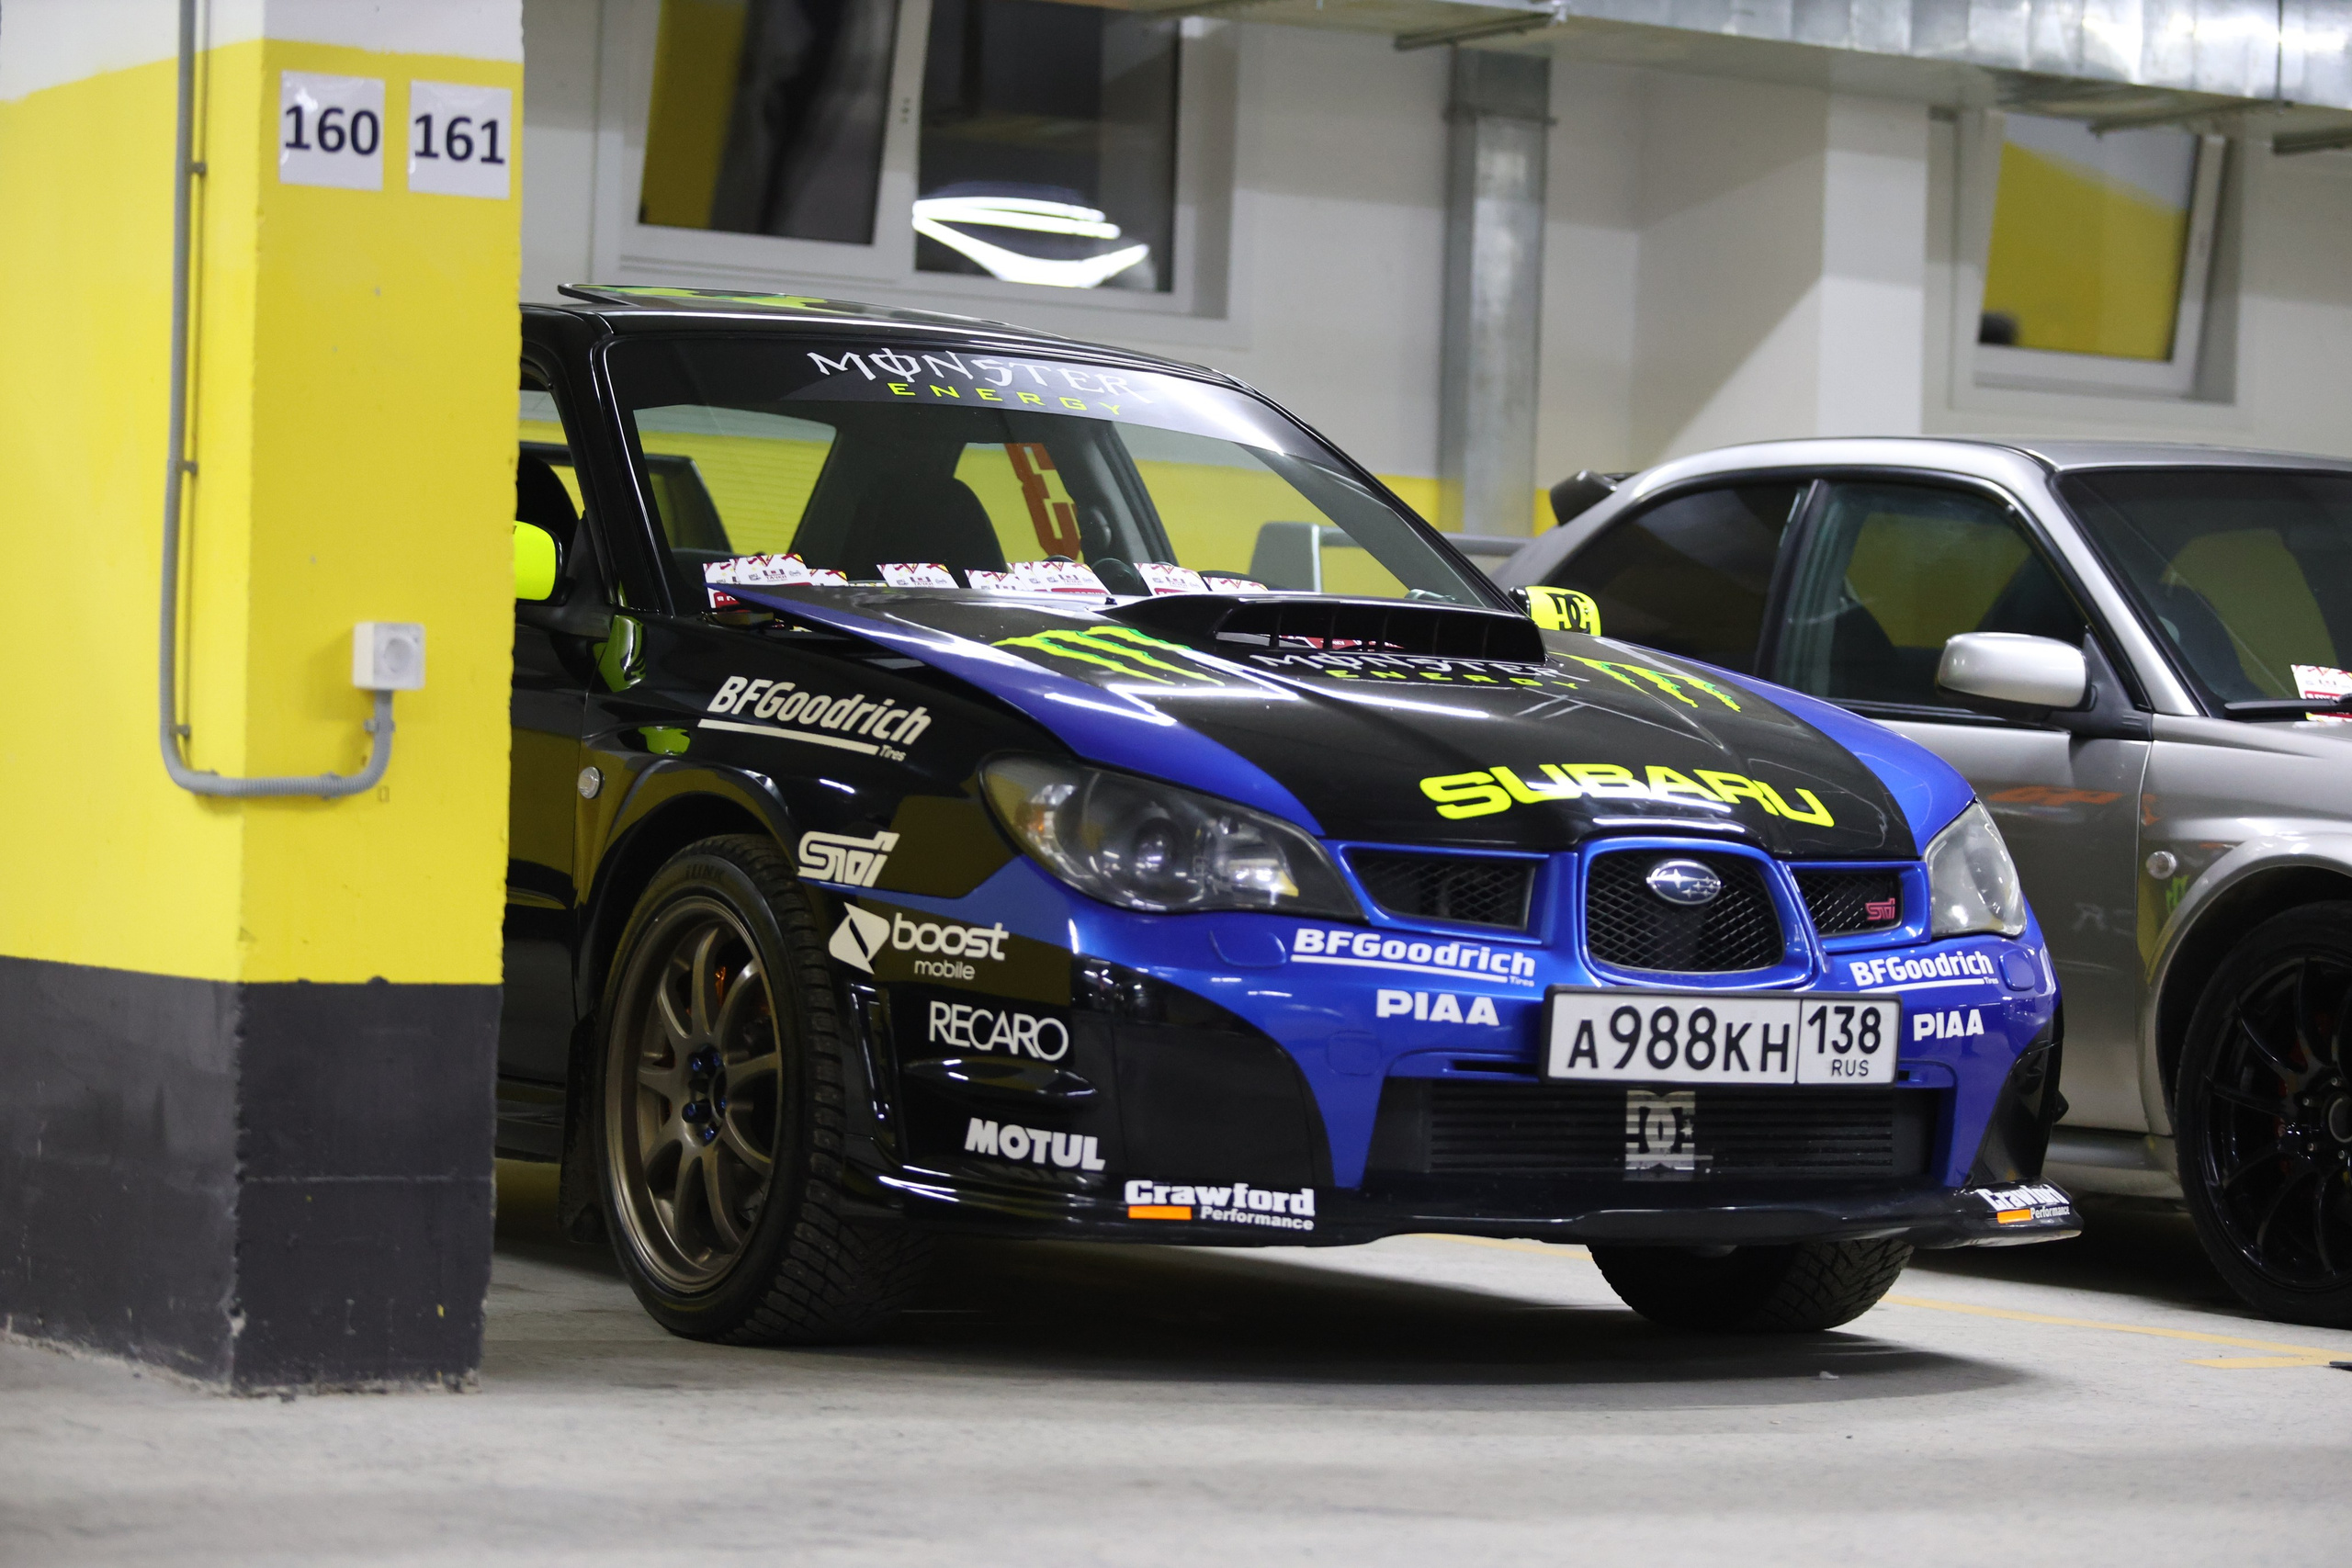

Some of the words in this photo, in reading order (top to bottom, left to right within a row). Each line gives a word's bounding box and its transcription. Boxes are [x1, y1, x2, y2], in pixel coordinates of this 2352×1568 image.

[285, 105, 379, 155] 160
[414, 114, 504, 164] 161
[888, 382, 1120, 415] ENERGY
[1325, 670, 1578, 690] ENERGY
[707, 675, 932, 746] BFGoodrich
[878, 744, 907, 762] Tires
[1419, 763, 1835, 827] SUBARU
[891, 912, 1010, 961] boost
[1293, 928, 1536, 977] BFGoodrich
[914, 959, 976, 981] mobile
[1849, 950, 1994, 987] BFGoodrich
[1375, 988, 1500, 1027] PIAA
[1913, 1009, 1984, 1042] PIAA
[929, 1000, 1069, 1062] RECARO
[1807, 1005, 1883, 1055] 138
[1830, 1058, 1870, 1077] RUS
[964, 1117, 1106, 1172] MOTUL
[1124, 1179, 1316, 1217] Crawford
[2030, 1205, 2070, 1219] Performance
[1199, 1205, 1315, 1231] Performance
